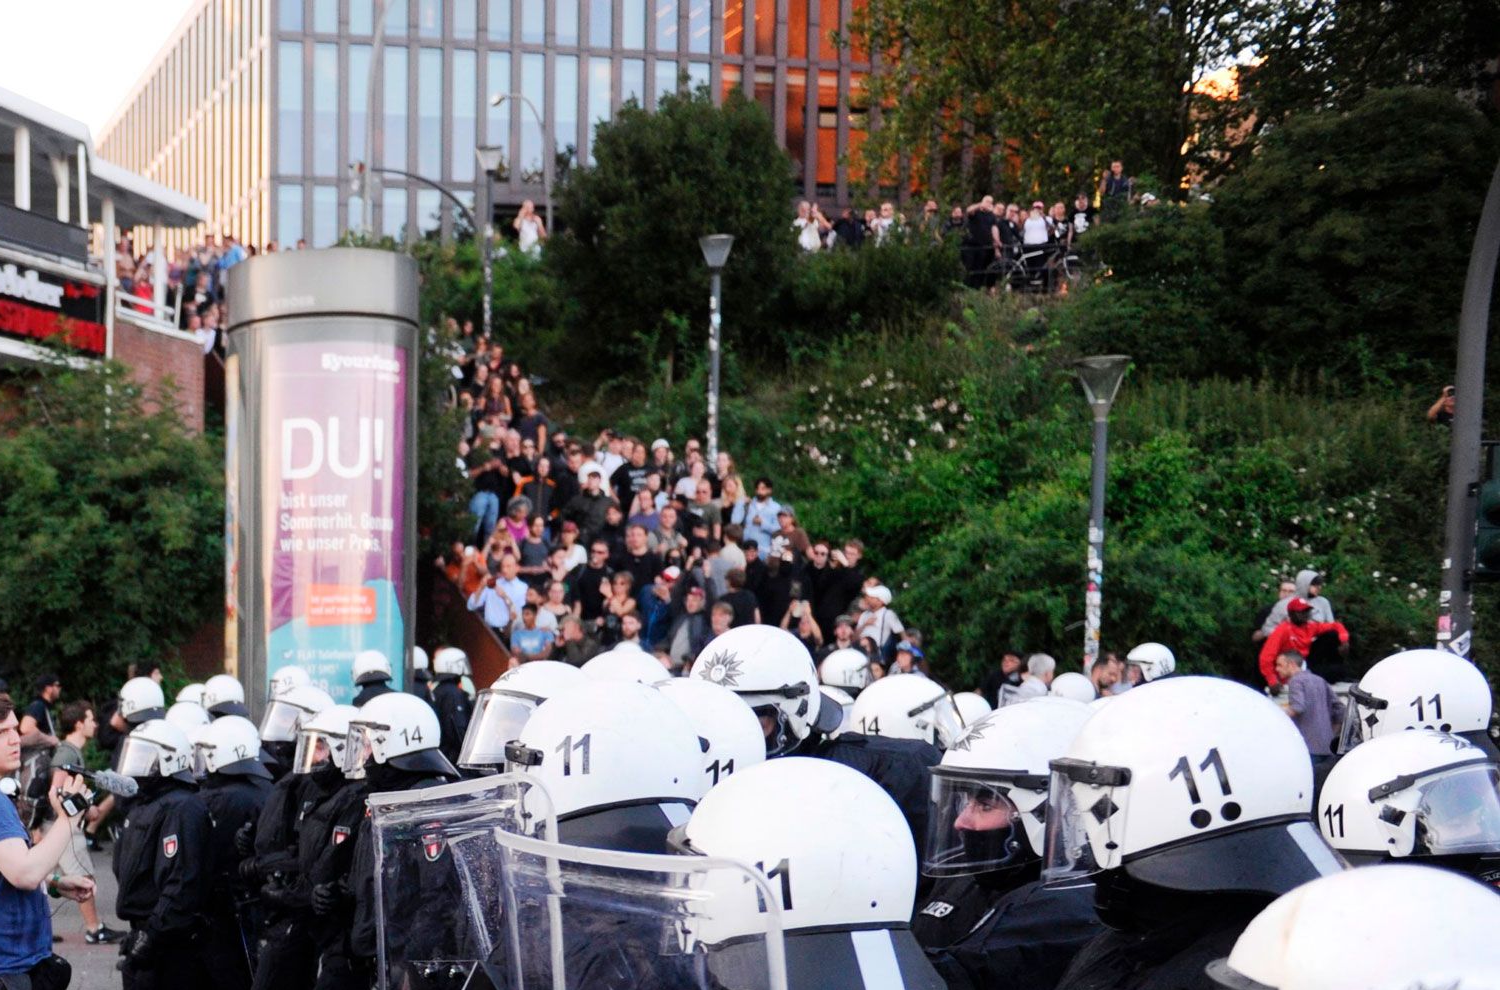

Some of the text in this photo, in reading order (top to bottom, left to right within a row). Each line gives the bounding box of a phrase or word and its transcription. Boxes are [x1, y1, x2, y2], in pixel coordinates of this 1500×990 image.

[281, 416, 384, 479] DU!
[280, 491, 348, 509] bist unser
[280, 538, 303, 552] wie
[308, 538, 344, 551] unser
[1409, 693, 1442, 722] 11
[400, 725, 423, 746] 14
[859, 716, 880, 736] 14
[177, 754, 186, 769] 12
[233, 744, 248, 759] 12
[555, 733, 591, 776] 11
[705, 758, 734, 787] 11
[1167, 747, 1232, 805] 11
[1324, 803, 1344, 838] 11
